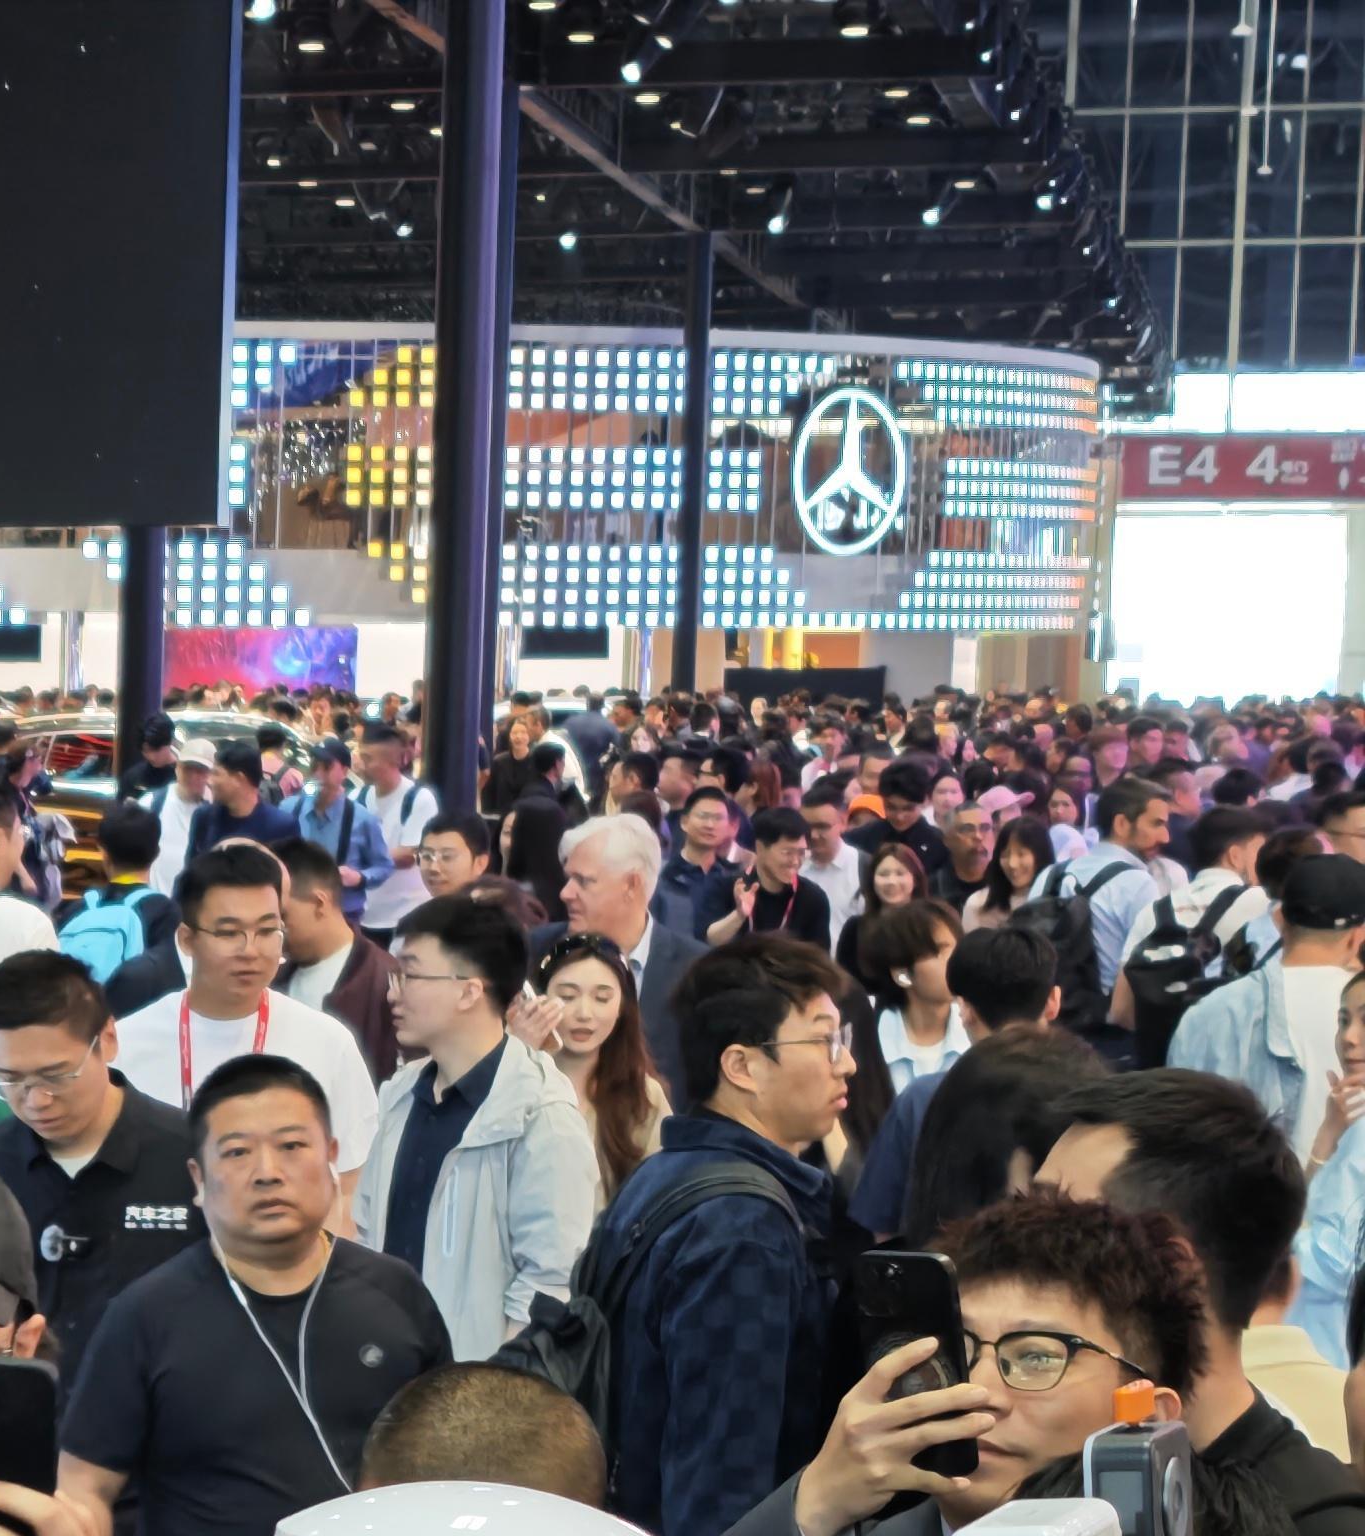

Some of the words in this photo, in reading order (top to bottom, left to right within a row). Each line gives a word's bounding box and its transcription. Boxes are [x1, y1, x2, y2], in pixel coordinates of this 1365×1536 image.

[1148, 445, 1219, 485] E4
[124, 1205, 189, 1221] 汽车之家
